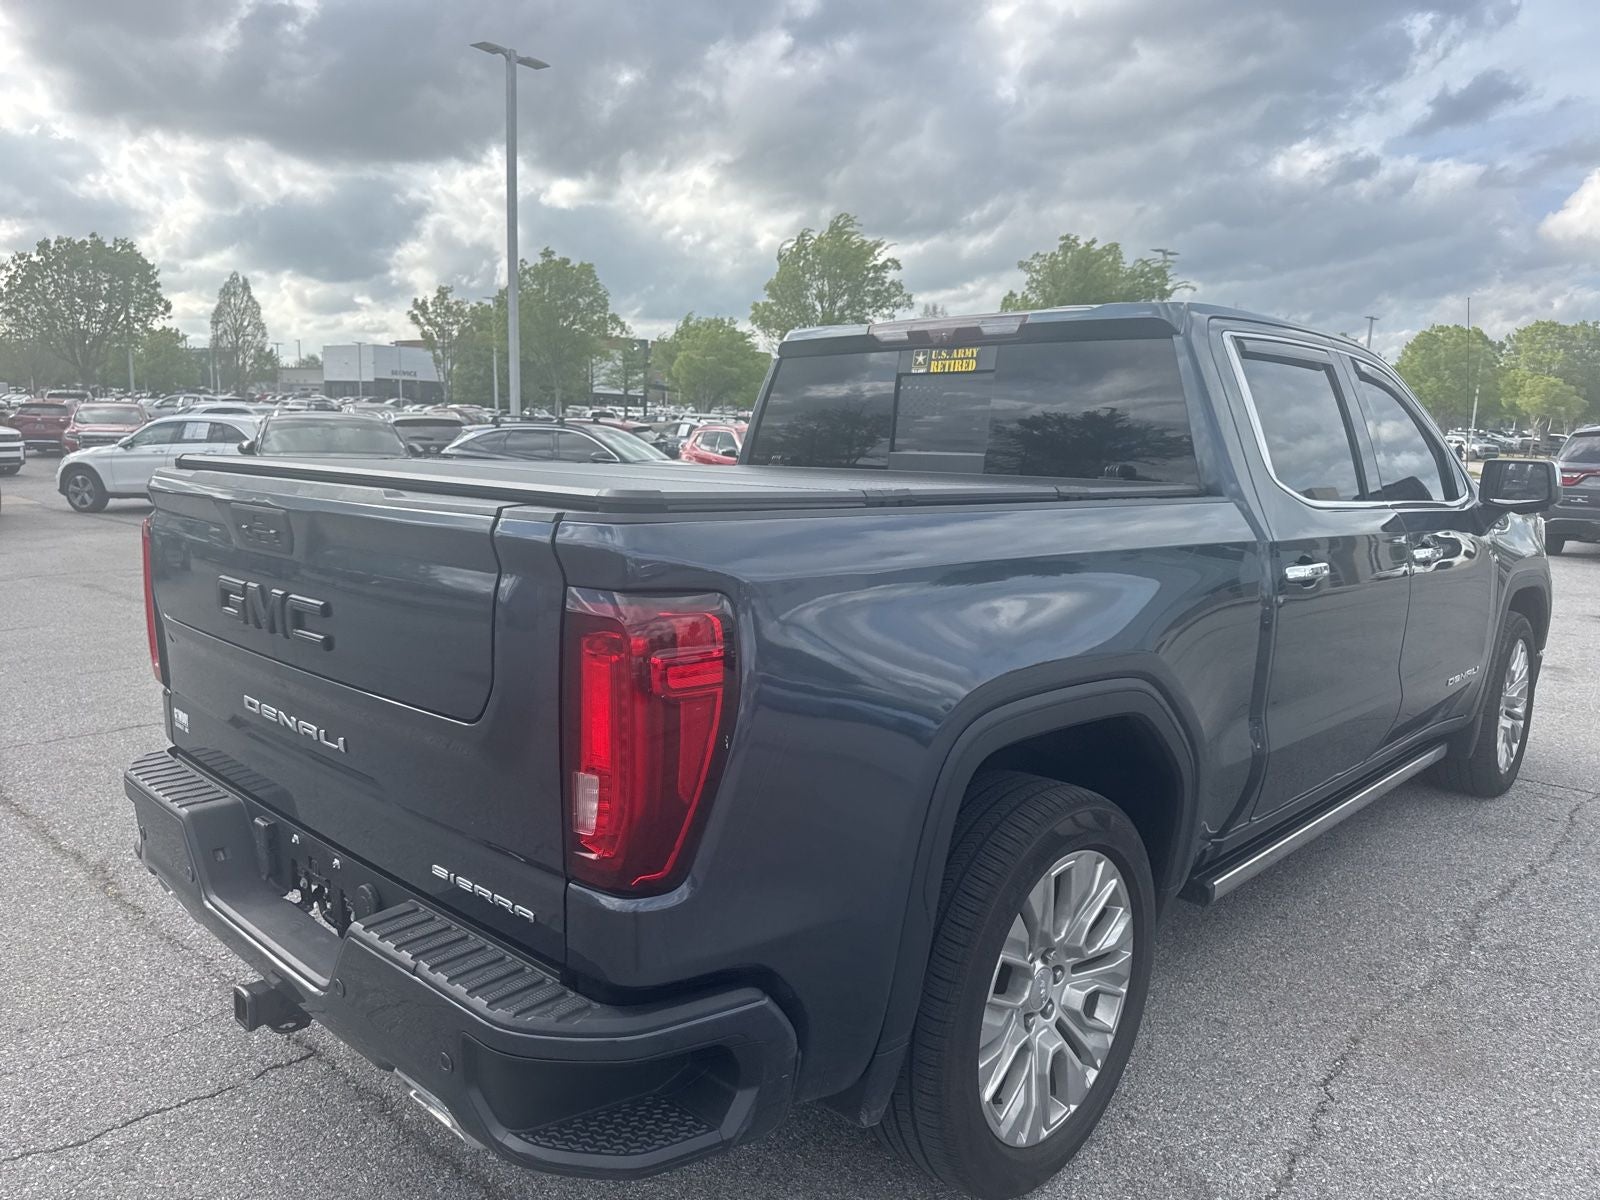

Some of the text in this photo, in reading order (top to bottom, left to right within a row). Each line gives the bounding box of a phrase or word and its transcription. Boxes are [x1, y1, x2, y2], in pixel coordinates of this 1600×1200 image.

[929, 359, 977, 373] RETIRED
[931, 347, 979, 359] U.S. ARMY
[217, 575, 335, 652] GMC
[1448, 665, 1480, 686] DENALI
[243, 694, 347, 753] DENALI
[431, 864, 535, 923] SIERRA
